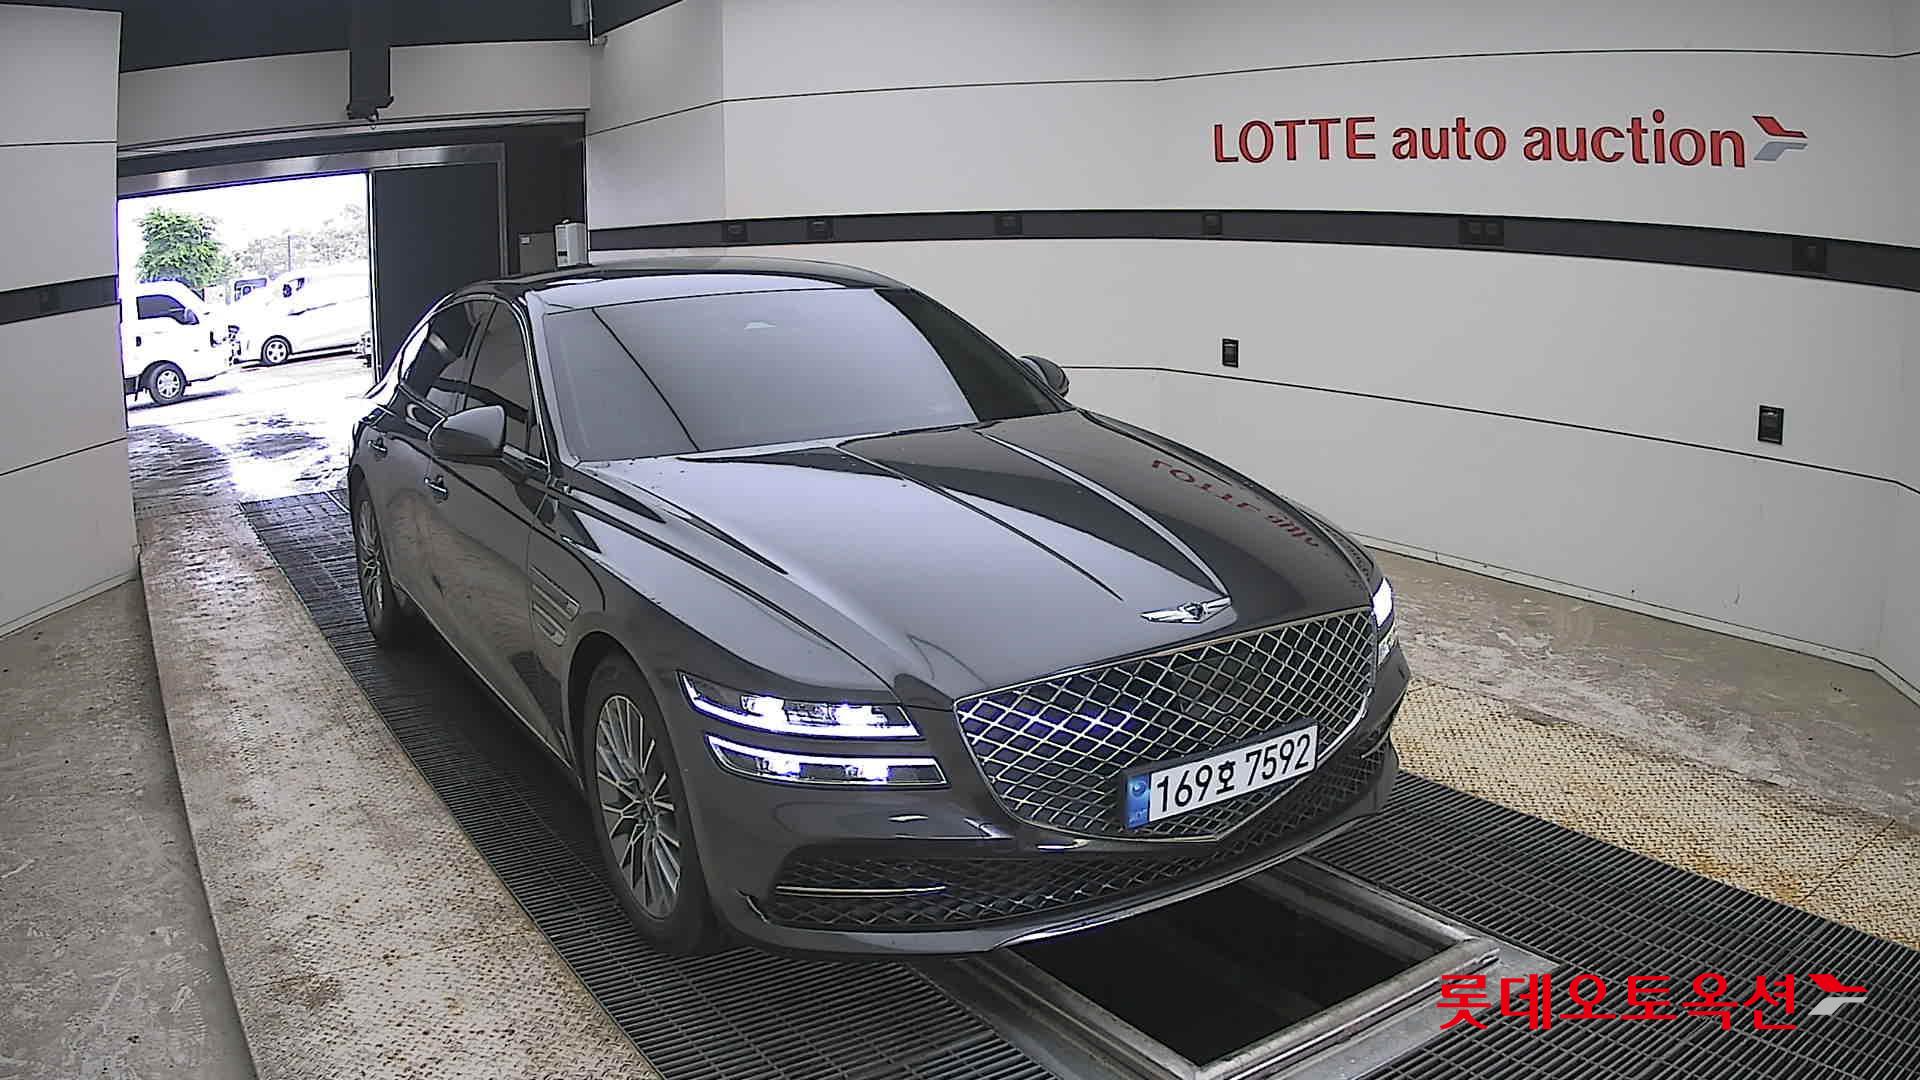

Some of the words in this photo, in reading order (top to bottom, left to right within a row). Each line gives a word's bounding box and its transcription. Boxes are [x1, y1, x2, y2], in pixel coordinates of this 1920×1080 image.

[1214, 116, 1376, 163] LOTTE
[1392, 117, 1506, 160] auto
[1522, 110, 1746, 168] auction
[1156, 760, 1236, 813] 169호
[1245, 733, 1311, 787] 7592
